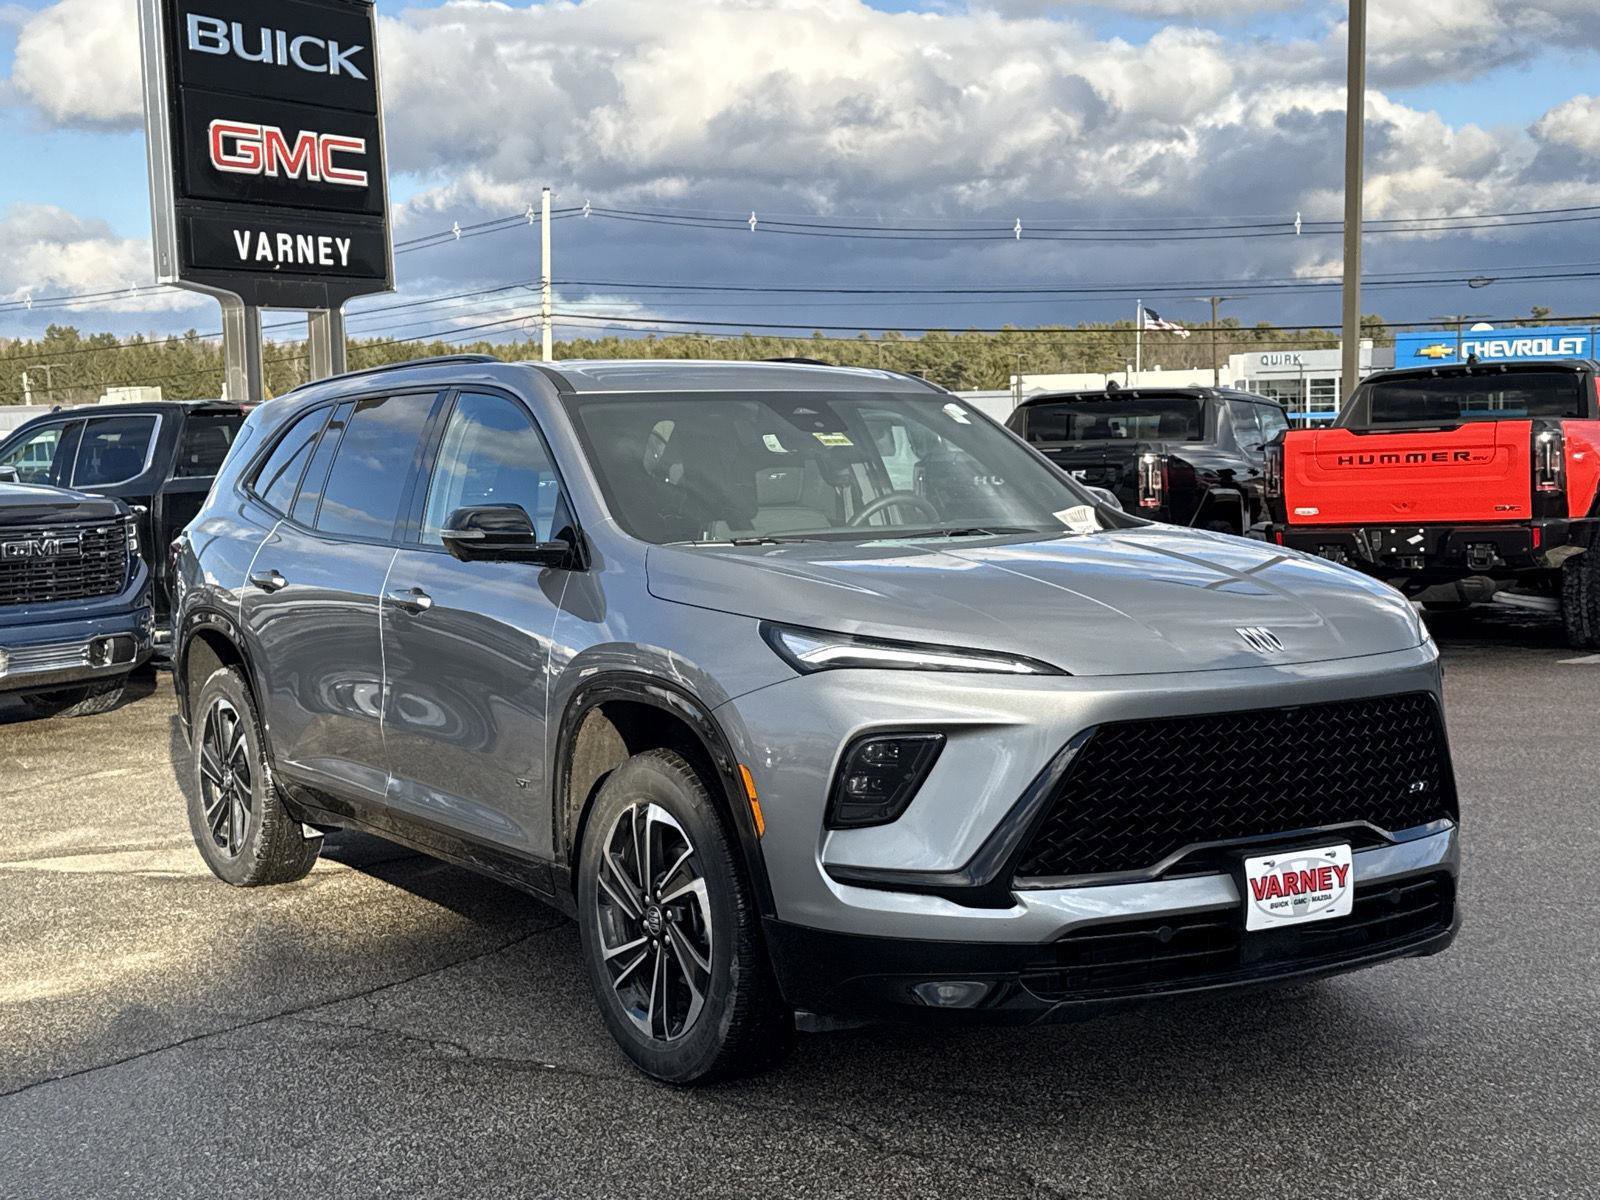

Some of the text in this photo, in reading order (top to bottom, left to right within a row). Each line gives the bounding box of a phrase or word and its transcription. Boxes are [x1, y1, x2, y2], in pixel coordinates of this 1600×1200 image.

[187, 13, 368, 80] BUICK
[208, 119, 368, 187] GMC
[233, 229, 351, 266] VARNEY
[1461, 337, 1586, 358] CHEVROLET
[1261, 354, 1302, 366] QUIRK
[1337, 451, 1471, 466] HUMMER
[1, 538, 79, 558] GMC
[1249, 863, 1350, 902] VARNEY
[1270, 894, 1332, 909] BUICK GMC MAZDA
